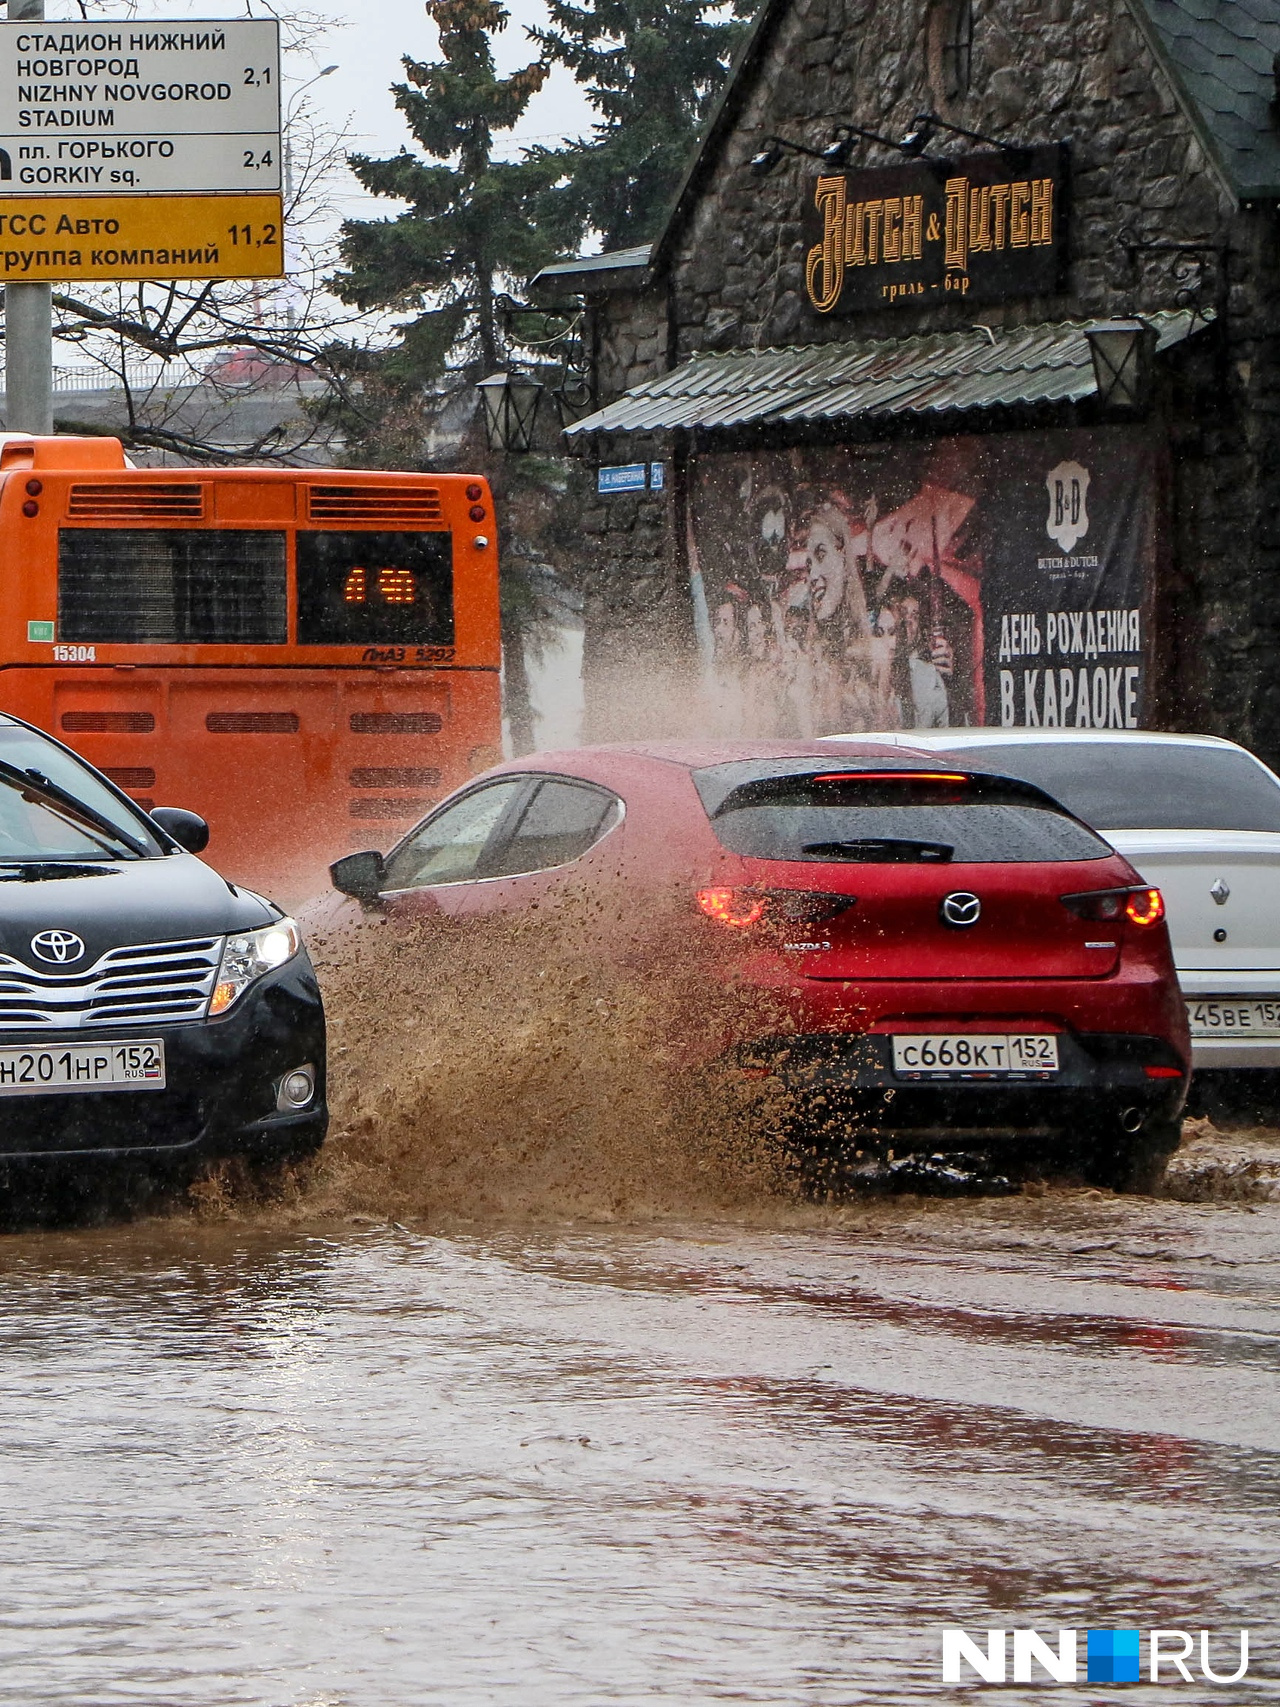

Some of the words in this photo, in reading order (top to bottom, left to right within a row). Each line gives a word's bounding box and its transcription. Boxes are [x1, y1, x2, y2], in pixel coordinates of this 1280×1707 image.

[16, 33, 121, 54] СТАДИОН
[129, 29, 226, 50] НИЖНИЙ
[17, 59, 139, 78] НОВГОРОД
[243, 67, 271, 86] 2,1
[18, 85, 98, 102] NIZHNY
[105, 83, 231, 100] NOVGOROD
[18, 109, 115, 127] STADIUM
[19, 146, 50, 159] пл.
[58, 141, 174, 158] ГОРЬКОГО
[243, 151, 273, 169] 2,4
[19, 166, 103, 184] GORKIY
[110, 170, 141, 187] sq.
[56, 214, 120, 235] Авто
[926, 212, 941, 241] &
[227, 224, 276, 247] 11,2
[91, 243, 219, 265] компаний
[882, 281, 924, 302] гриль
[944, 273, 970, 295] бар
[999, 613, 1041, 663] ДЕНЬ
[1047, 609, 1140, 660] РОЖДЕНИЯ
[52, 645, 96, 662] 15304
[1000, 669, 1015, 728] В
[1024, 666, 1139, 729] КАРАОКЕ
[1186, 1003, 1251, 1027] 45ВЕ
[903, 1039, 1005, 1067] С668КТ
[1012, 1038, 1051, 1059] 152
[1021, 1059, 1041, 1067] RUS
[0, 1052, 108, 1083] Н201НР
[116, 1046, 155, 1069] 152
[125, 1069, 145, 1078] RUS
